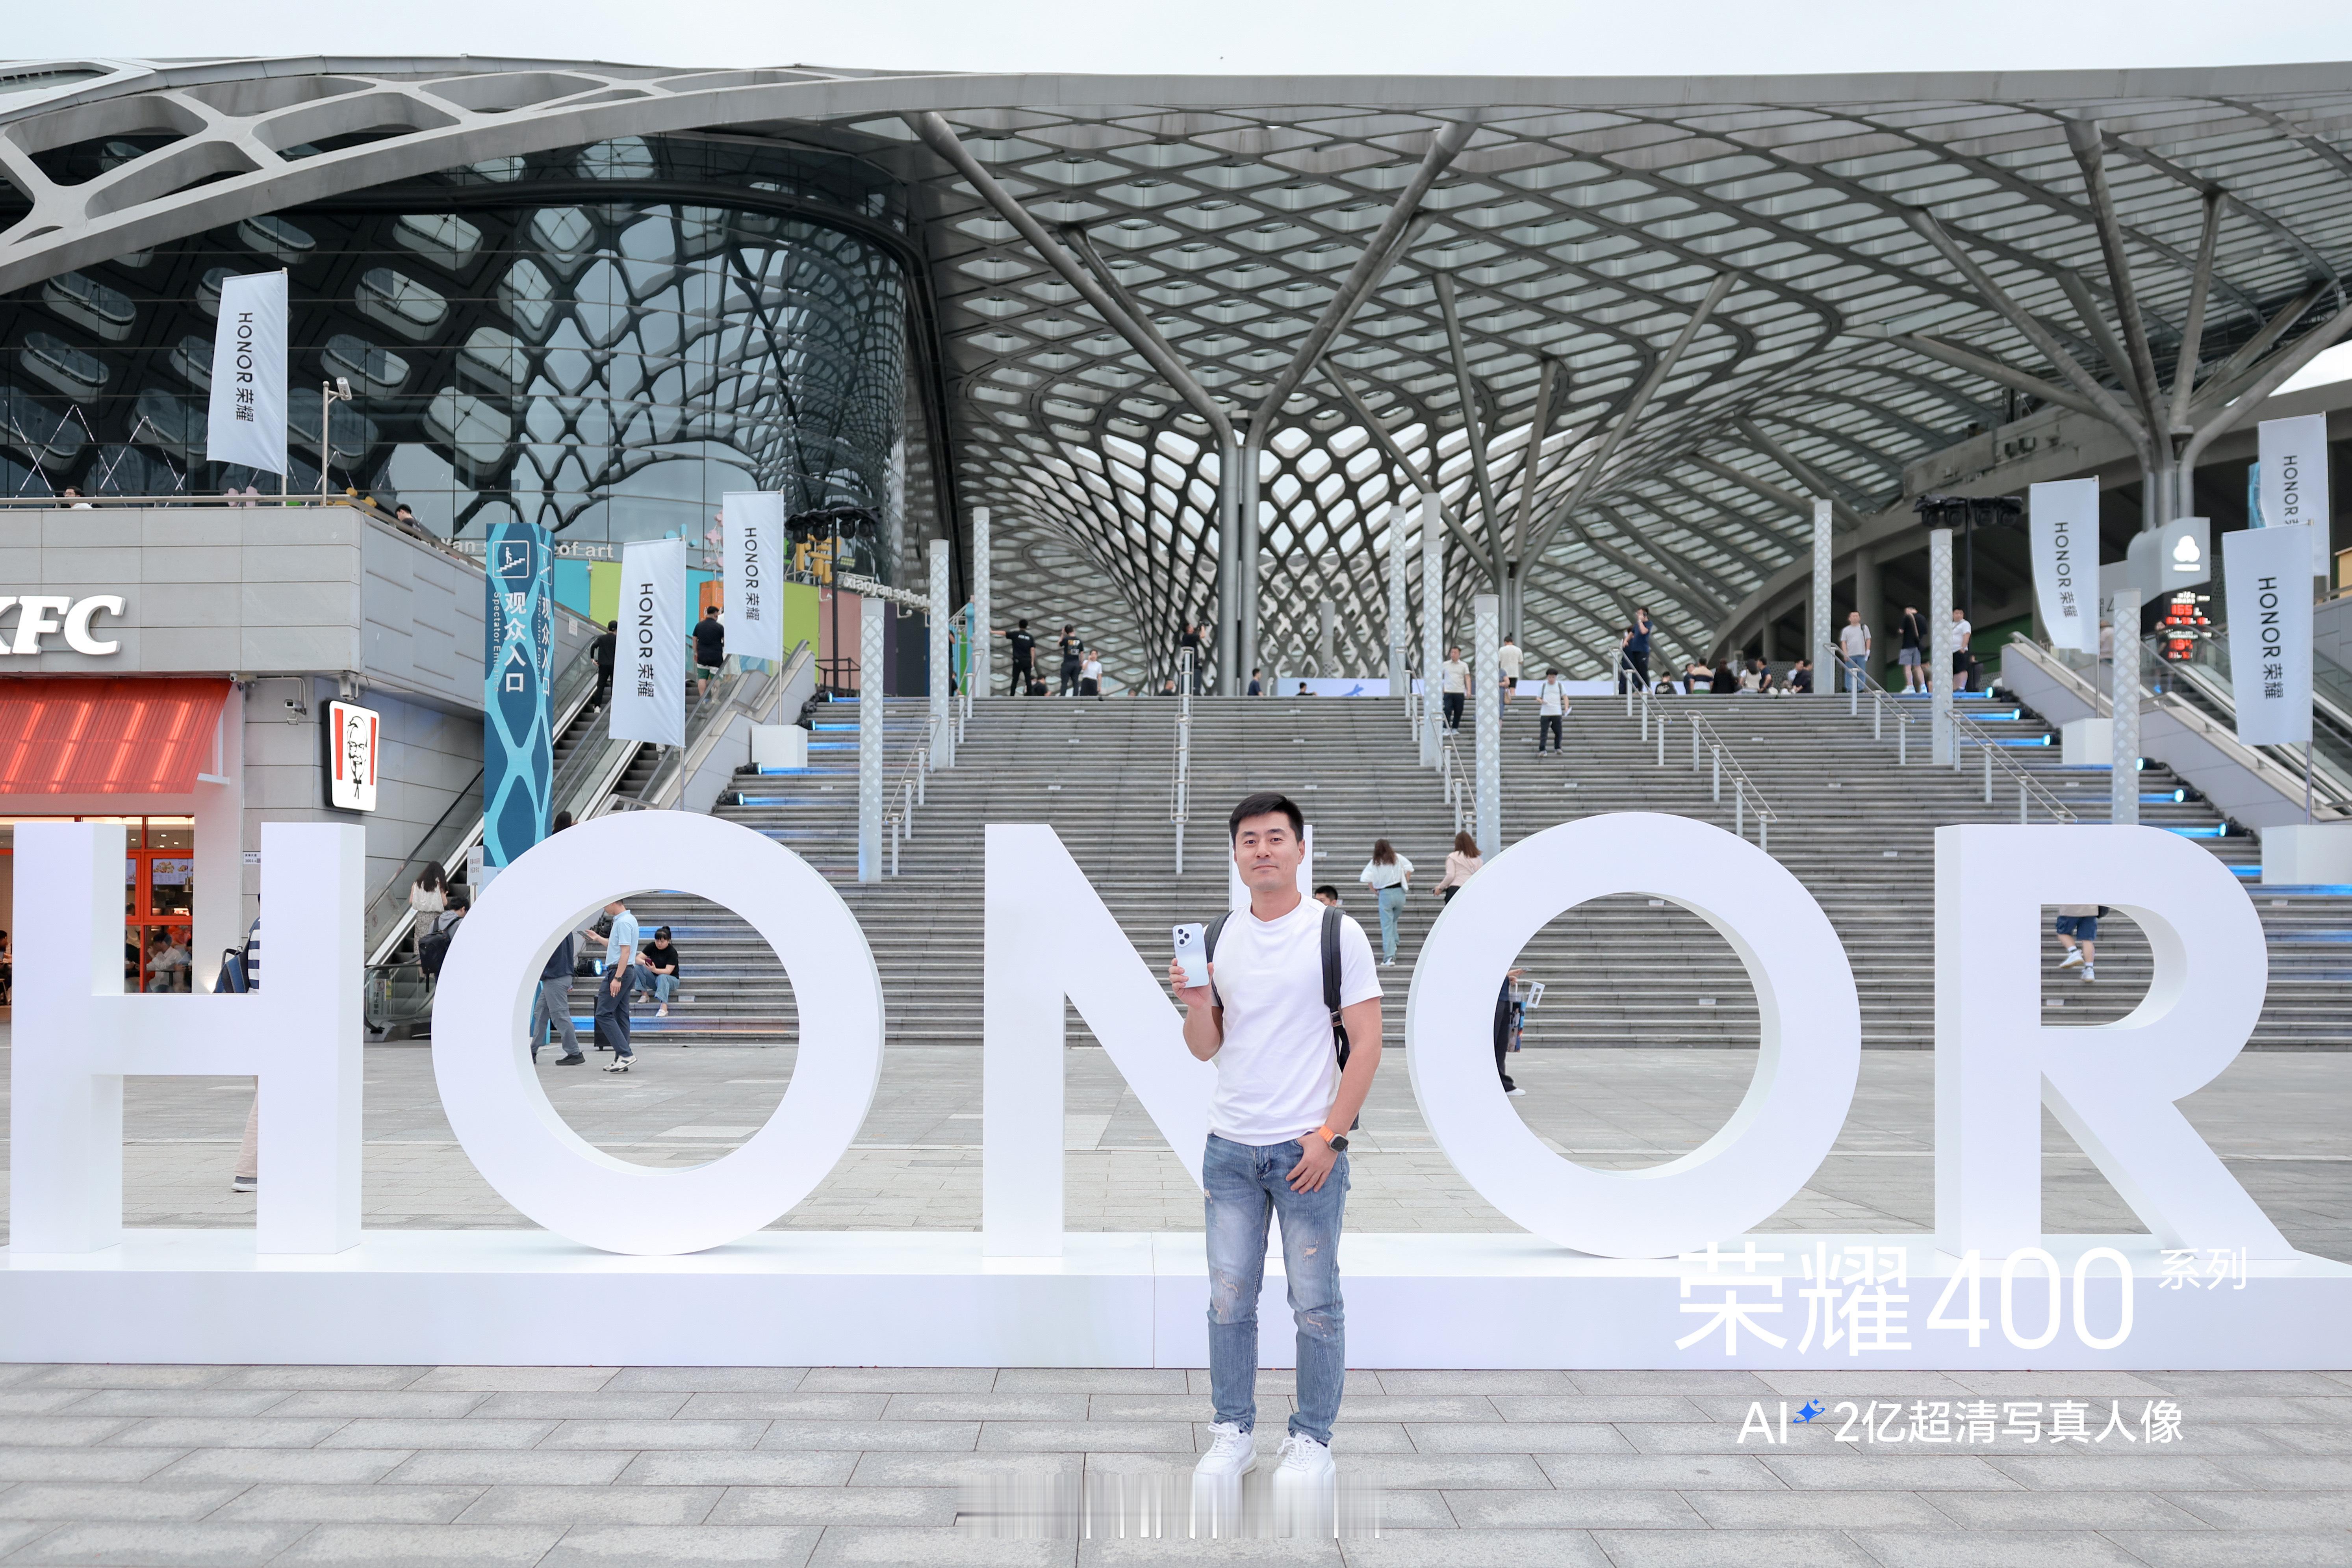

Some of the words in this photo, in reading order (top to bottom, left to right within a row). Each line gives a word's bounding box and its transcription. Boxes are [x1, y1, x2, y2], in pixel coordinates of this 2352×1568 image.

[236, 312, 253, 383] HONOR
[235, 387, 254, 422] 荣耀
[2283, 455, 2299, 516] HONOR
[559, 542, 579, 556] of
[585, 543, 614, 559] art
[744, 527, 759, 588] HONOR
[2055, 522, 2072, 588] HONOR
[492, 592, 501, 643] Spectator
[638, 583, 653, 659] HONOR
[745, 592, 760, 621] 荣耀
[844, 575, 892, 597] xiaoyan
[894, 588, 927, 606] school
[2060, 592, 2078, 618] 荣耀
[2258, 577, 2282, 659] HONOR
[504, 592, 527, 693] 观众入口
[542, 596, 551, 697] 观众入口
[637, 663, 655, 698] 荣耀
[2262, 663, 2283, 700] 荣耀
[9, 811, 2298, 1258] HONOR
